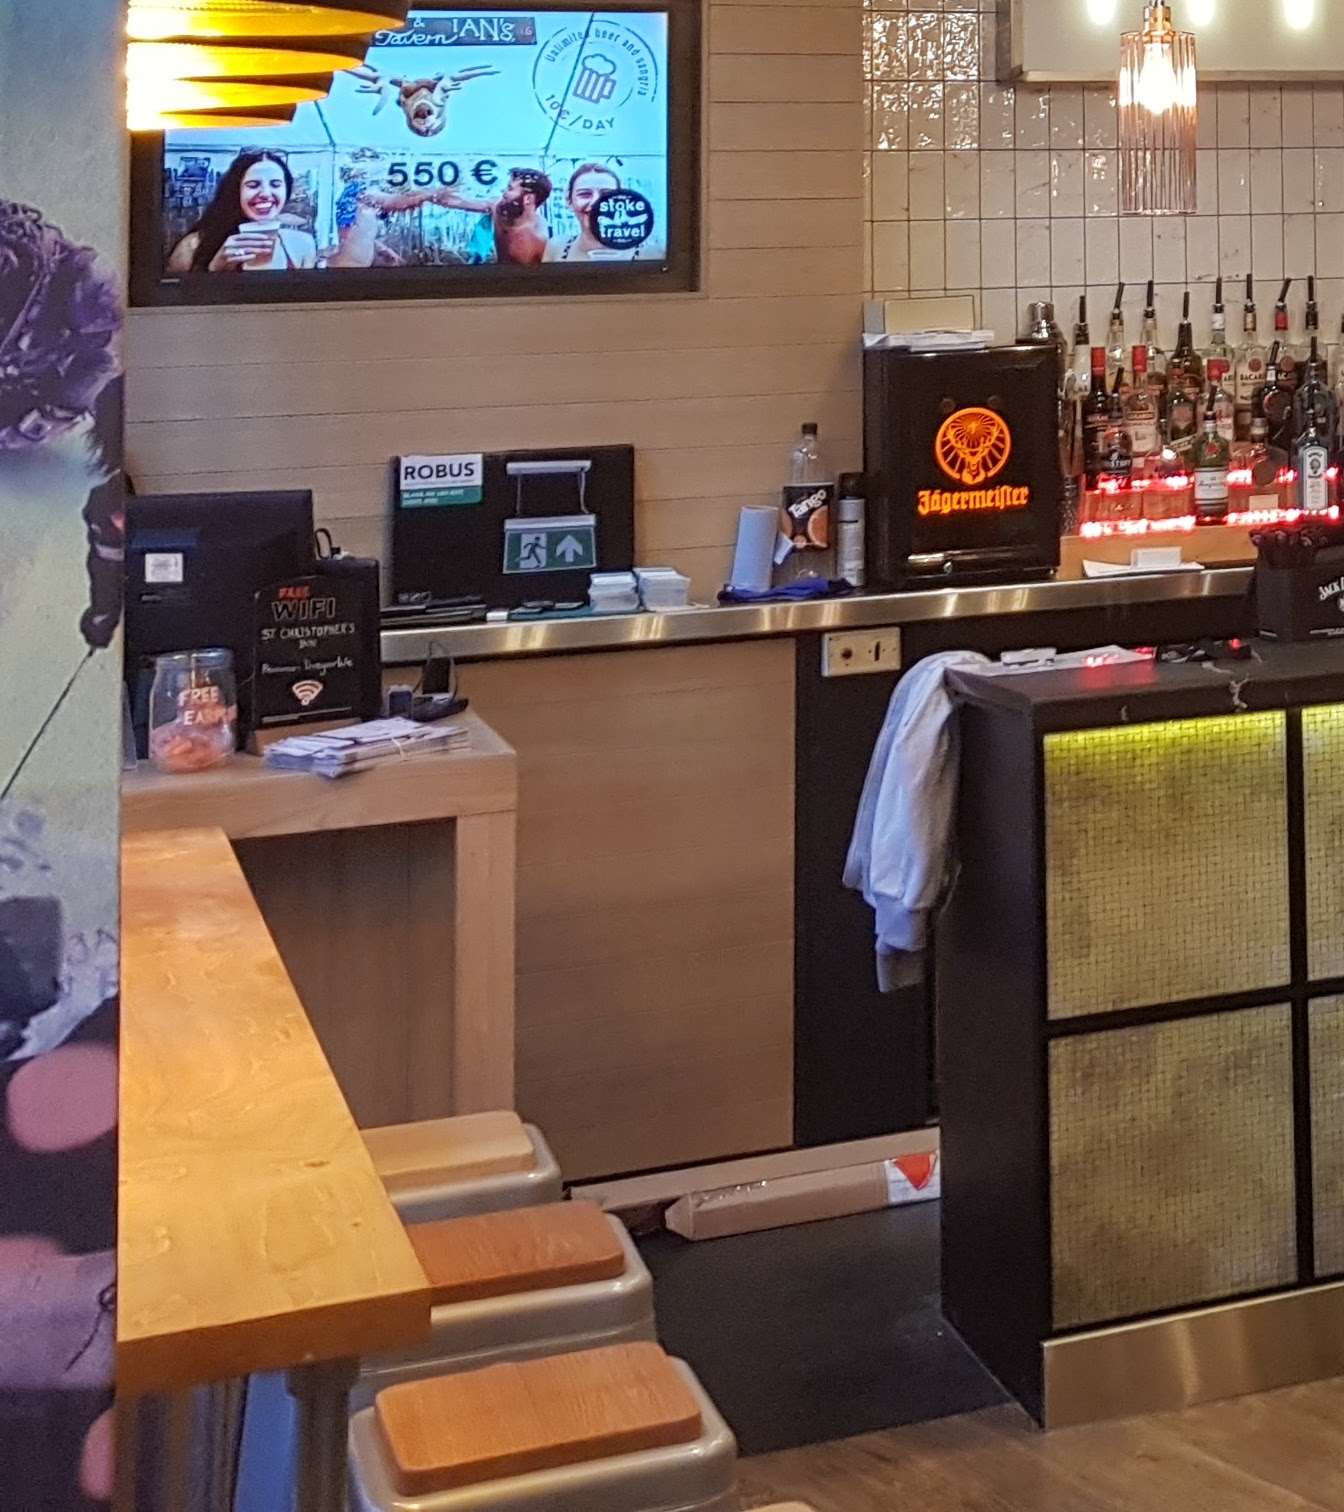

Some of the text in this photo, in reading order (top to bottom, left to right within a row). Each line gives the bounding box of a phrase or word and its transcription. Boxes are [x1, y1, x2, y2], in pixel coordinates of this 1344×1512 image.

[375, 29, 458, 46] Tavern
[595, 27, 620, 41] beer
[622, 39, 639, 55] and
[387, 160, 498, 187] 550 €
[599, 198, 645, 212] stoke
[599, 224, 645, 238] travel
[404, 462, 476, 480] ROBUS
[788, 489, 828, 519] Tango
[917, 485, 1031, 516] Jägermeister
[1318, 581, 1341, 601] JACK
[271, 597, 336, 621] WIFI
[178, 685, 220, 707] FREE
